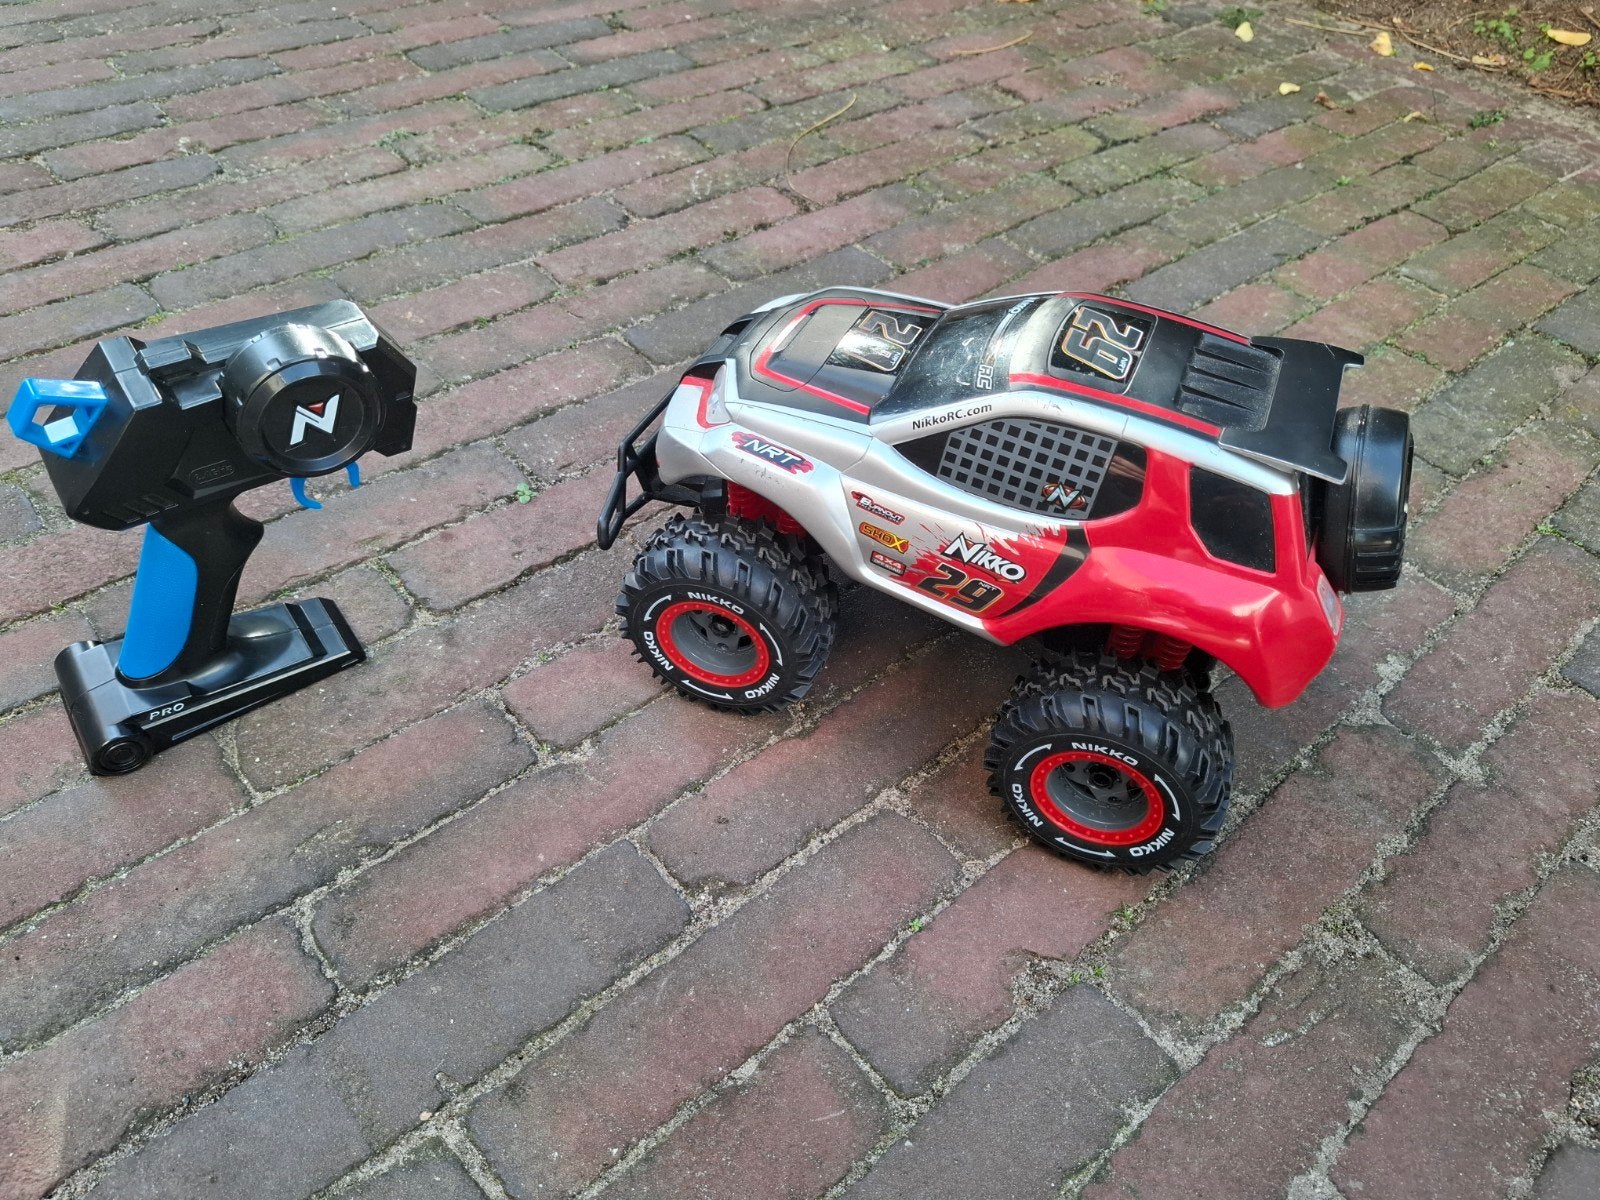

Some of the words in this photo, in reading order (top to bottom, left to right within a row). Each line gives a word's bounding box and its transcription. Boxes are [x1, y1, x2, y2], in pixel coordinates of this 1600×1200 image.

[1061, 306, 1144, 380] 29
[976, 365, 994, 390] RC
[912, 404, 993, 430] NikkoRC.com
[743, 439, 802, 463] NRT
[917, 562, 1005, 613] 29
[978, 581, 998, 592] NRT
[687, 591, 744, 615] NIKKO
[643, 631, 674, 671] NIKKO
[744, 672, 781, 699] NIKKO
[149, 703, 184, 720] PRO
[1071, 741, 1139, 766] NIKKO
[1011, 783, 1044, 828] NIKKO
[1129, 827, 1175, 857] NIKKO
